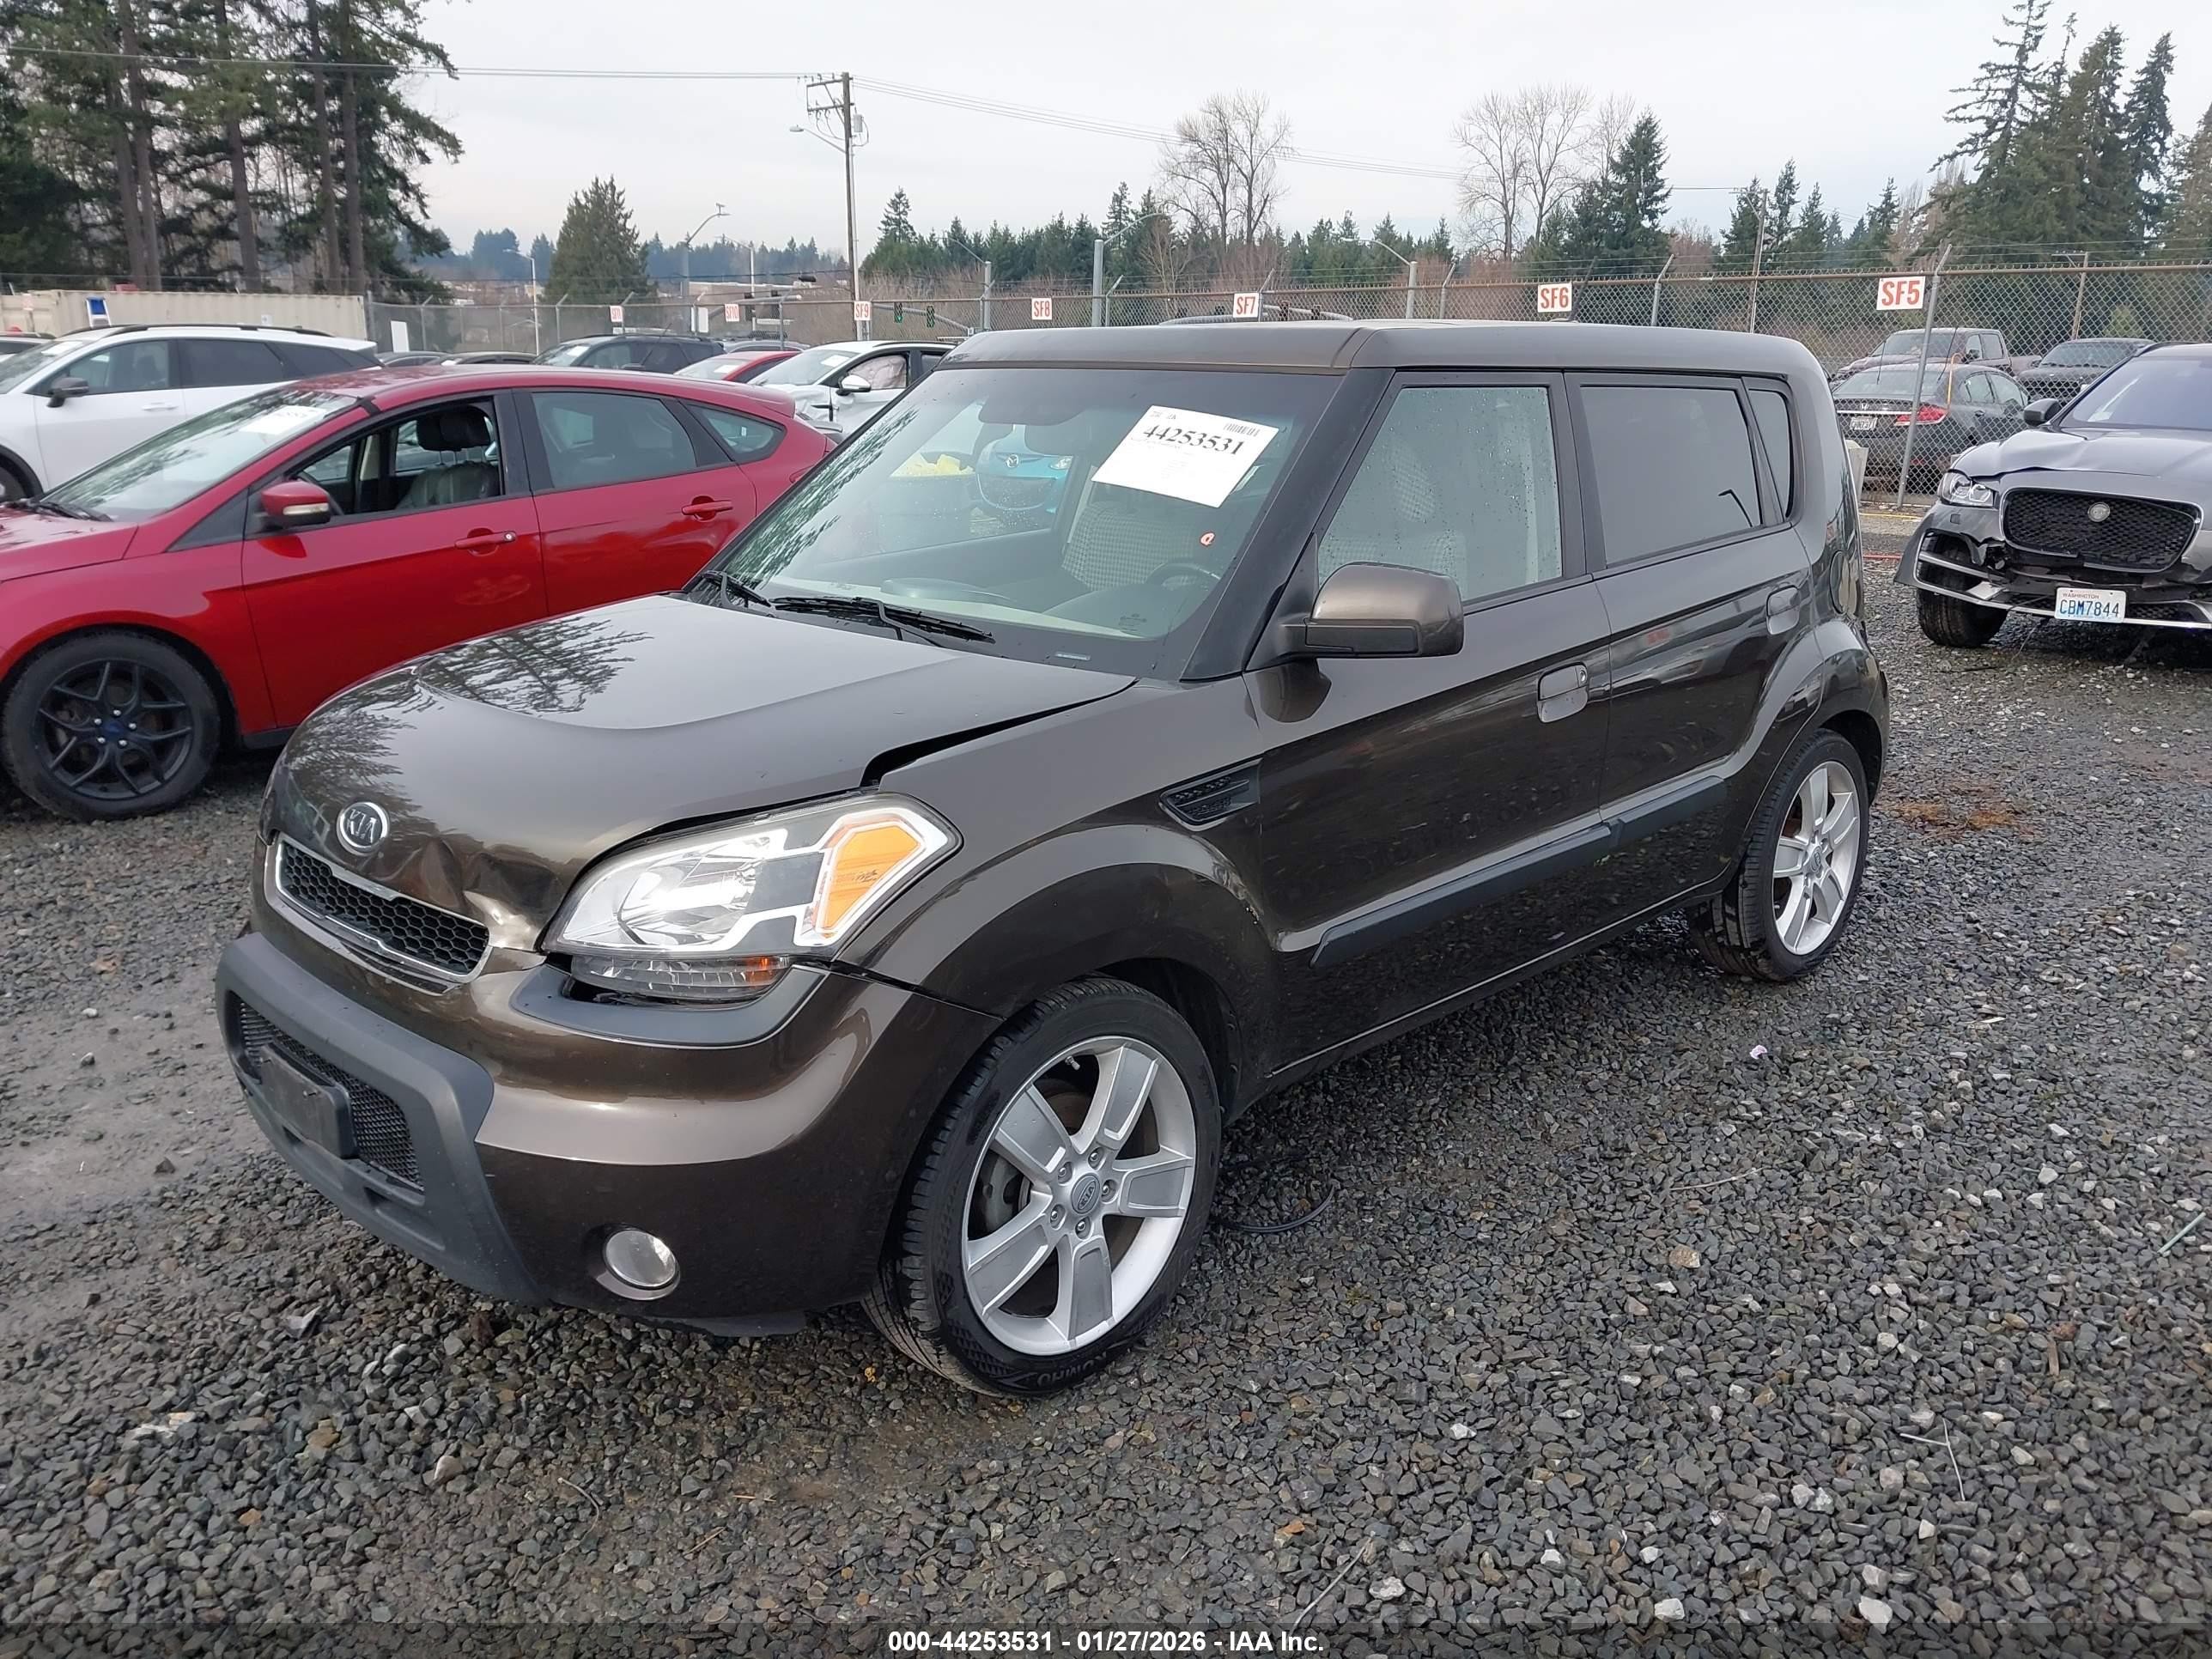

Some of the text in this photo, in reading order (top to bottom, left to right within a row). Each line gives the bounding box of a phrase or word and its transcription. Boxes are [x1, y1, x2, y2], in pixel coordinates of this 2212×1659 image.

[1540, 287, 1569, 309] SF6
[1881, 280, 1921, 306] SF5
[855, 301, 870, 318] SF9
[1033, 301, 1050, 317] SF8
[1237, 296, 1256, 315] SF7
[1143, 424, 1246, 455] 44253531
[2059, 599, 2120, 617] CBM7844
[346, 809, 378, 843] KIA
